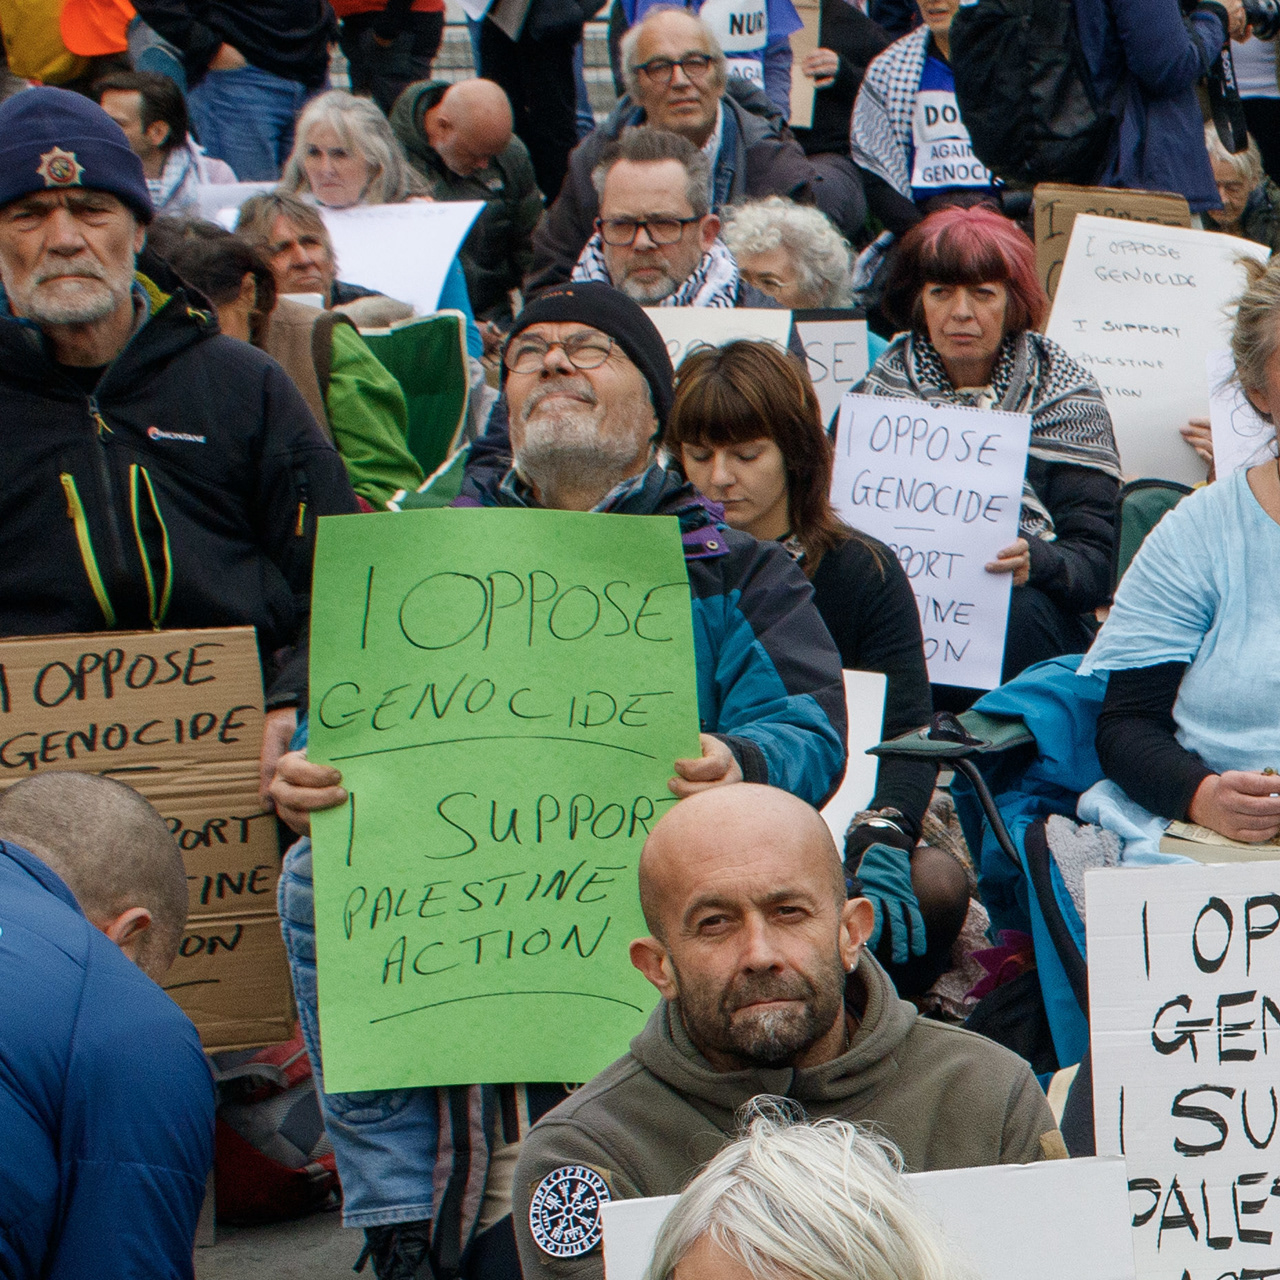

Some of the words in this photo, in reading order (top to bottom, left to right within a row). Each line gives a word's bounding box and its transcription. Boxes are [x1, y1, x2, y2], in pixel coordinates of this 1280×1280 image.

[922, 163, 988, 182] GENOCI
[1085, 236, 1096, 258] I
[1073, 319, 1087, 332] I
[1101, 320, 1182, 338] SUPPORT
[1104, 385, 1143, 399] TION
[847, 412, 855, 457] I
[869, 414, 1002, 466] OPPOSE
[851, 469, 1009, 523] GENOCIDE
[360, 565, 374, 650] I
[399, 569, 693, 652] OPPOSE
[33, 643, 225, 708] OPPOSE
[318, 673, 675, 732] GENOCIDE
[0, 705, 258, 771] GENOCIDE
[346, 791, 355, 868] I
[342, 859, 628, 941] PALESTINE
[381, 916, 612, 985] ACTION
[1141, 900, 1151, 981] I
[1118, 1085, 1125, 1155] I
